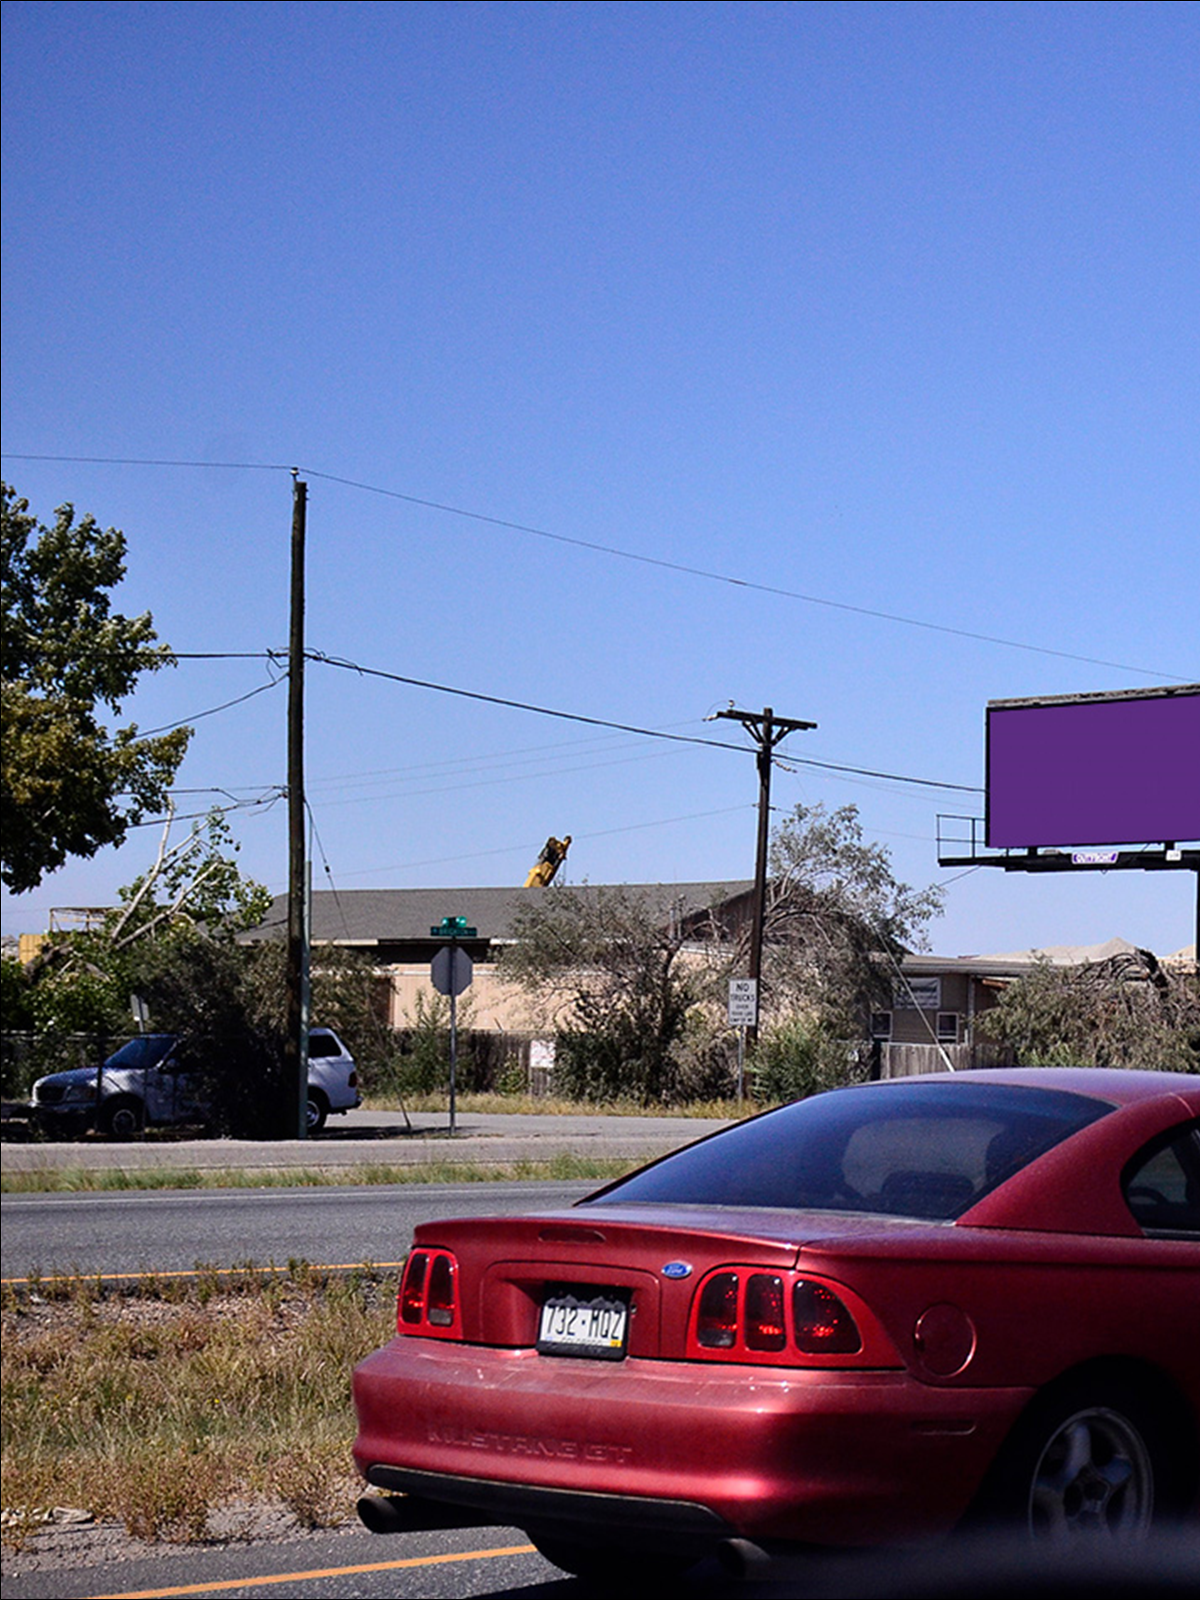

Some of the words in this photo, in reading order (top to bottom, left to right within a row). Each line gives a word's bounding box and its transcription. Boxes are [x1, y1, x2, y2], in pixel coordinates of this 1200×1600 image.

[736, 982, 750, 992] NO
[730, 993, 755, 1003] TRUCKS
[429, 1430, 577, 1459] MUSTANG
[585, 1444, 633, 1463] GT
